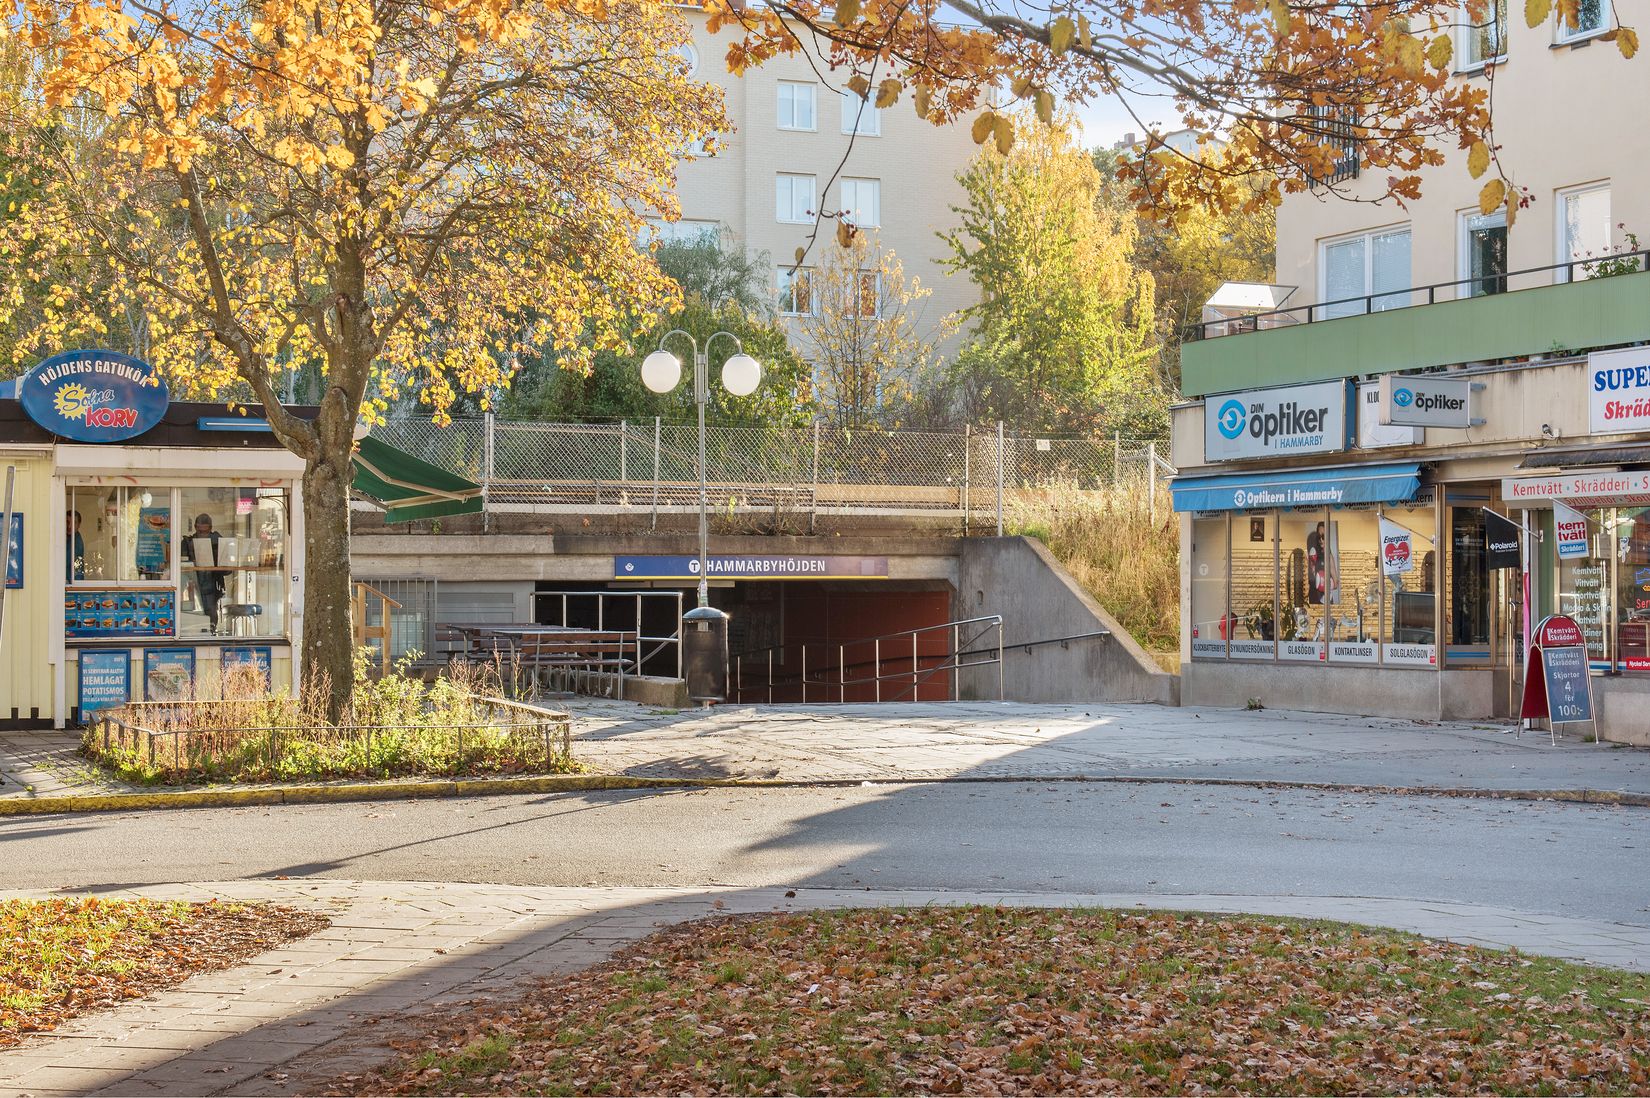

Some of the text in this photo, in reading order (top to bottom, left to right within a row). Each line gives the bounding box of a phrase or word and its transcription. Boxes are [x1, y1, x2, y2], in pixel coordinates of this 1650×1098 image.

[39, 360, 92, 386] HÖJDENS
[1594, 366, 1650, 392] SUPE
[62, 389, 115, 411] Solna
[1416, 395, 1465, 412] optiker
[1251, 403, 1264, 414] DIN
[85, 407, 138, 428] KORV
[1250, 402, 1328, 446] optiker
[1280, 435, 1324, 449] HAMMARBY
[1513, 481, 1563, 497] Kemtvätt
[1574, 477, 1630, 493] Skrädderi
[1247, 490, 1285, 506] Optikern
[1293, 487, 1343, 502] Hammarby
[1557, 521, 1585, 531] kem
[1384, 534, 1409, 544] Energizer
[1558, 530, 1586, 542] tvätt
[1495, 541, 1518, 550] Polaroid
[706, 559, 826, 572] HAMMARBYHÖJDEN
[1288, 645, 1315, 655] GLASÖGON
[1335, 647, 1373, 657] KONTAKTLINSER
[1390, 648, 1428, 659] SOLGLASÖGON
[83, 676, 124, 685] HEMLAGAT
[1564, 681, 1572, 692] 4
[83, 687, 124, 695] POTATISMOS
